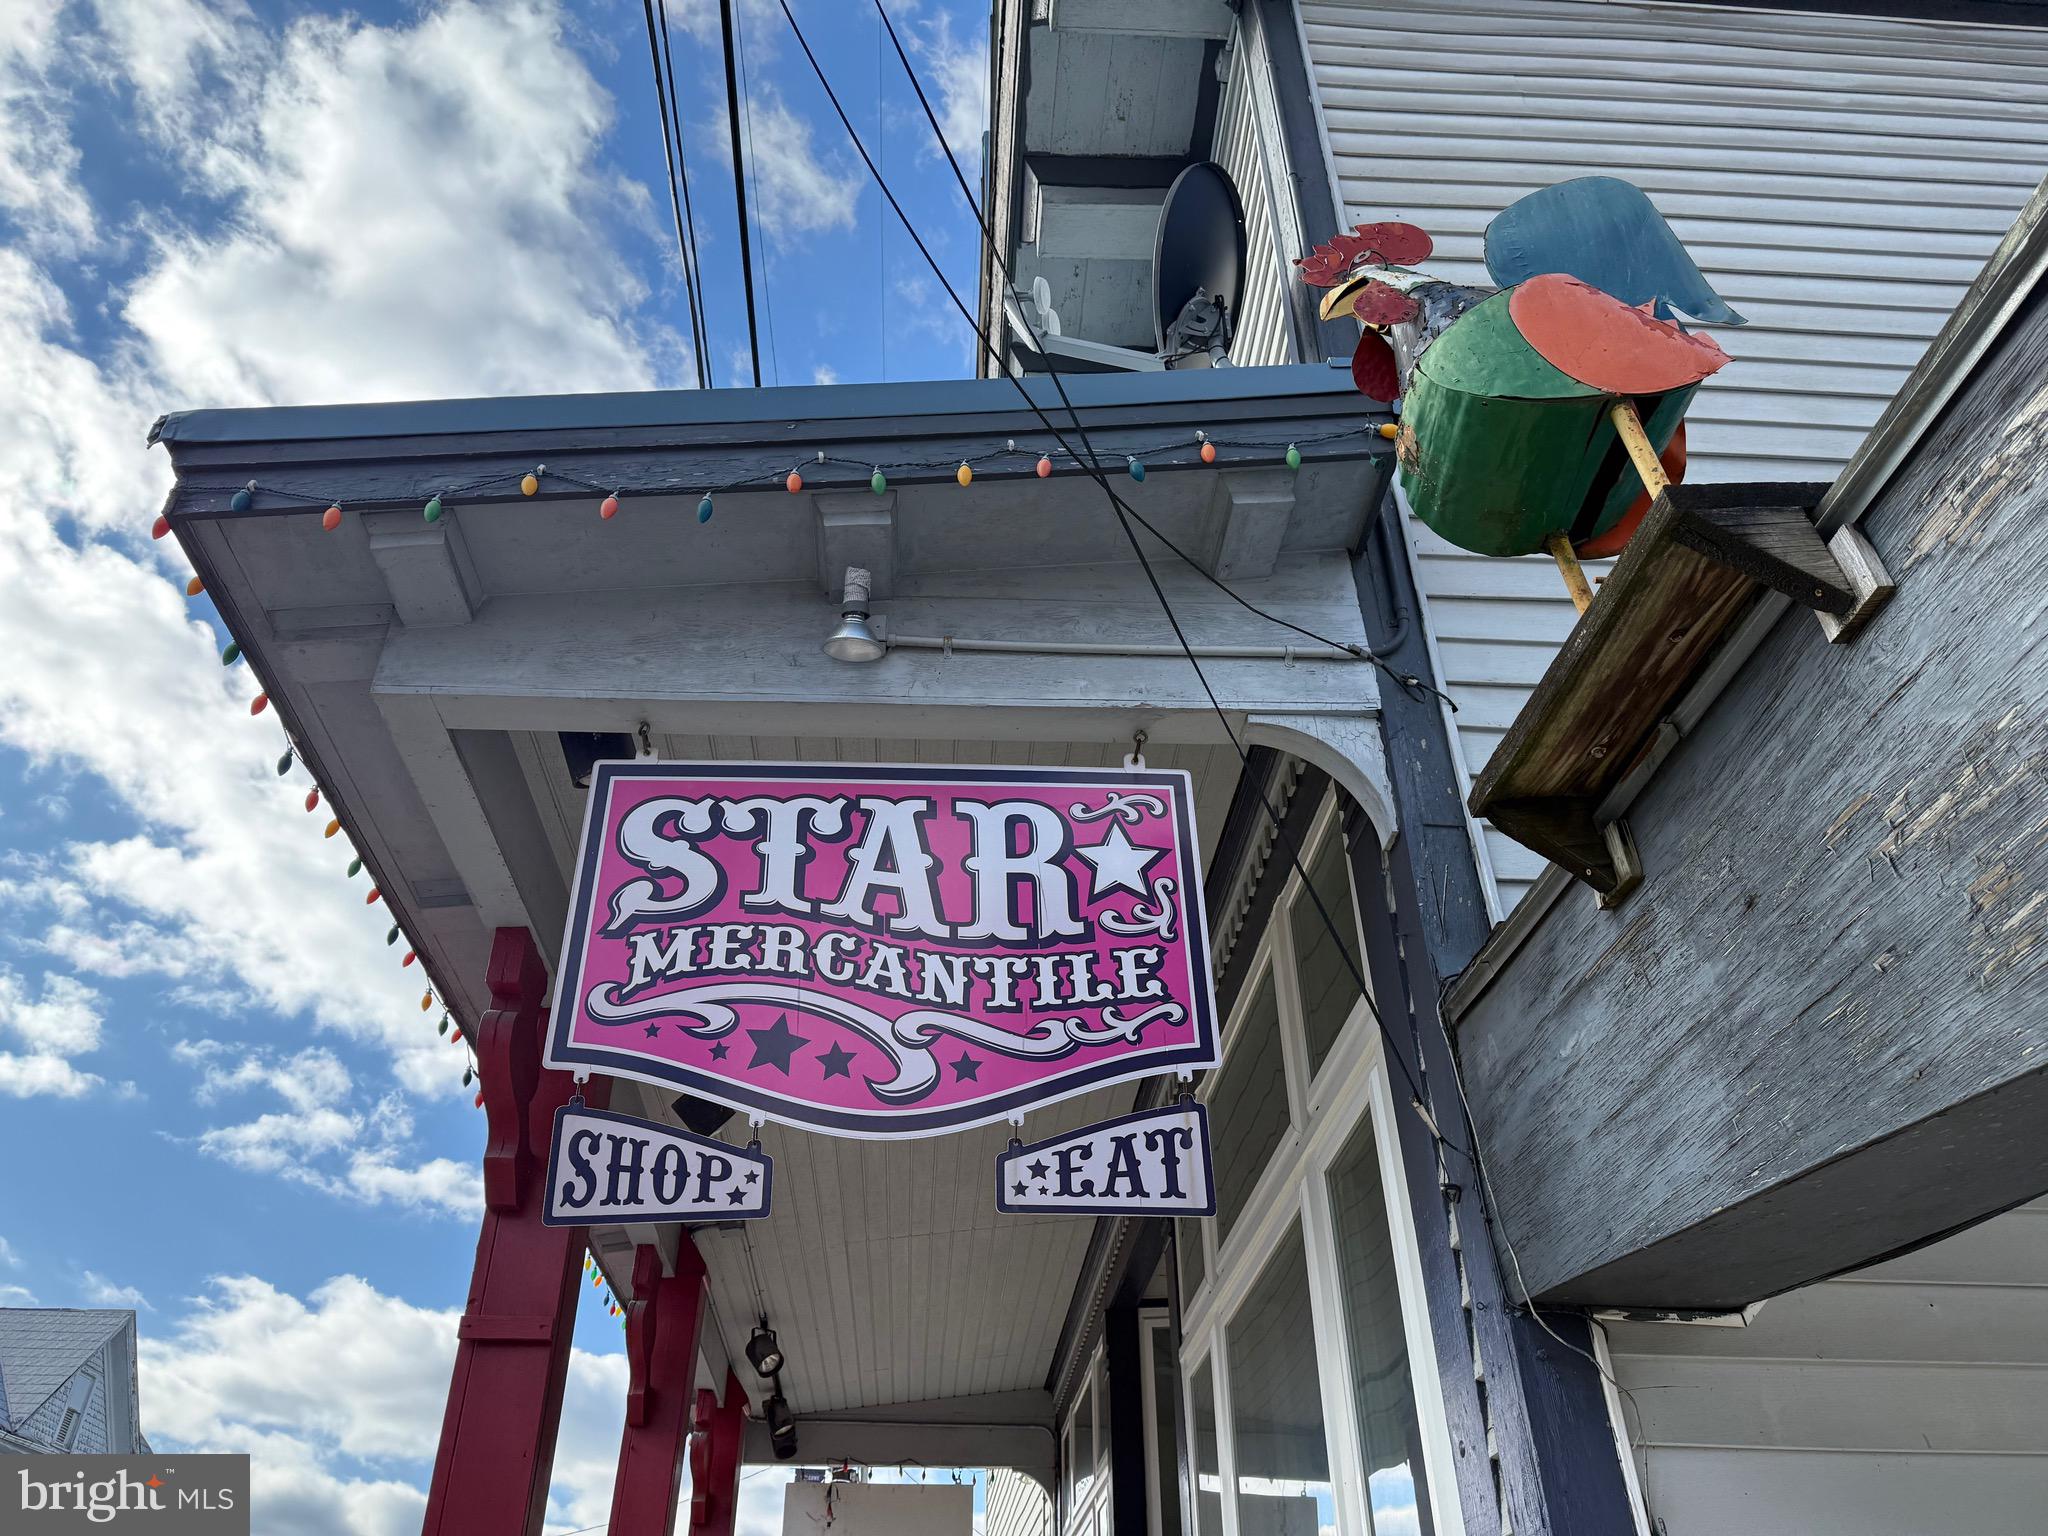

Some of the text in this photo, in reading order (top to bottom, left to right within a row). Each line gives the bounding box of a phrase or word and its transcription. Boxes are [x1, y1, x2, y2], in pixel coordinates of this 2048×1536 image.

[602, 796, 1087, 941] STAR
[621, 926, 1165, 1008] MERCANTILE
[560, 1129, 733, 1209] SHOP
[1054, 1127, 1194, 1199] EAT
